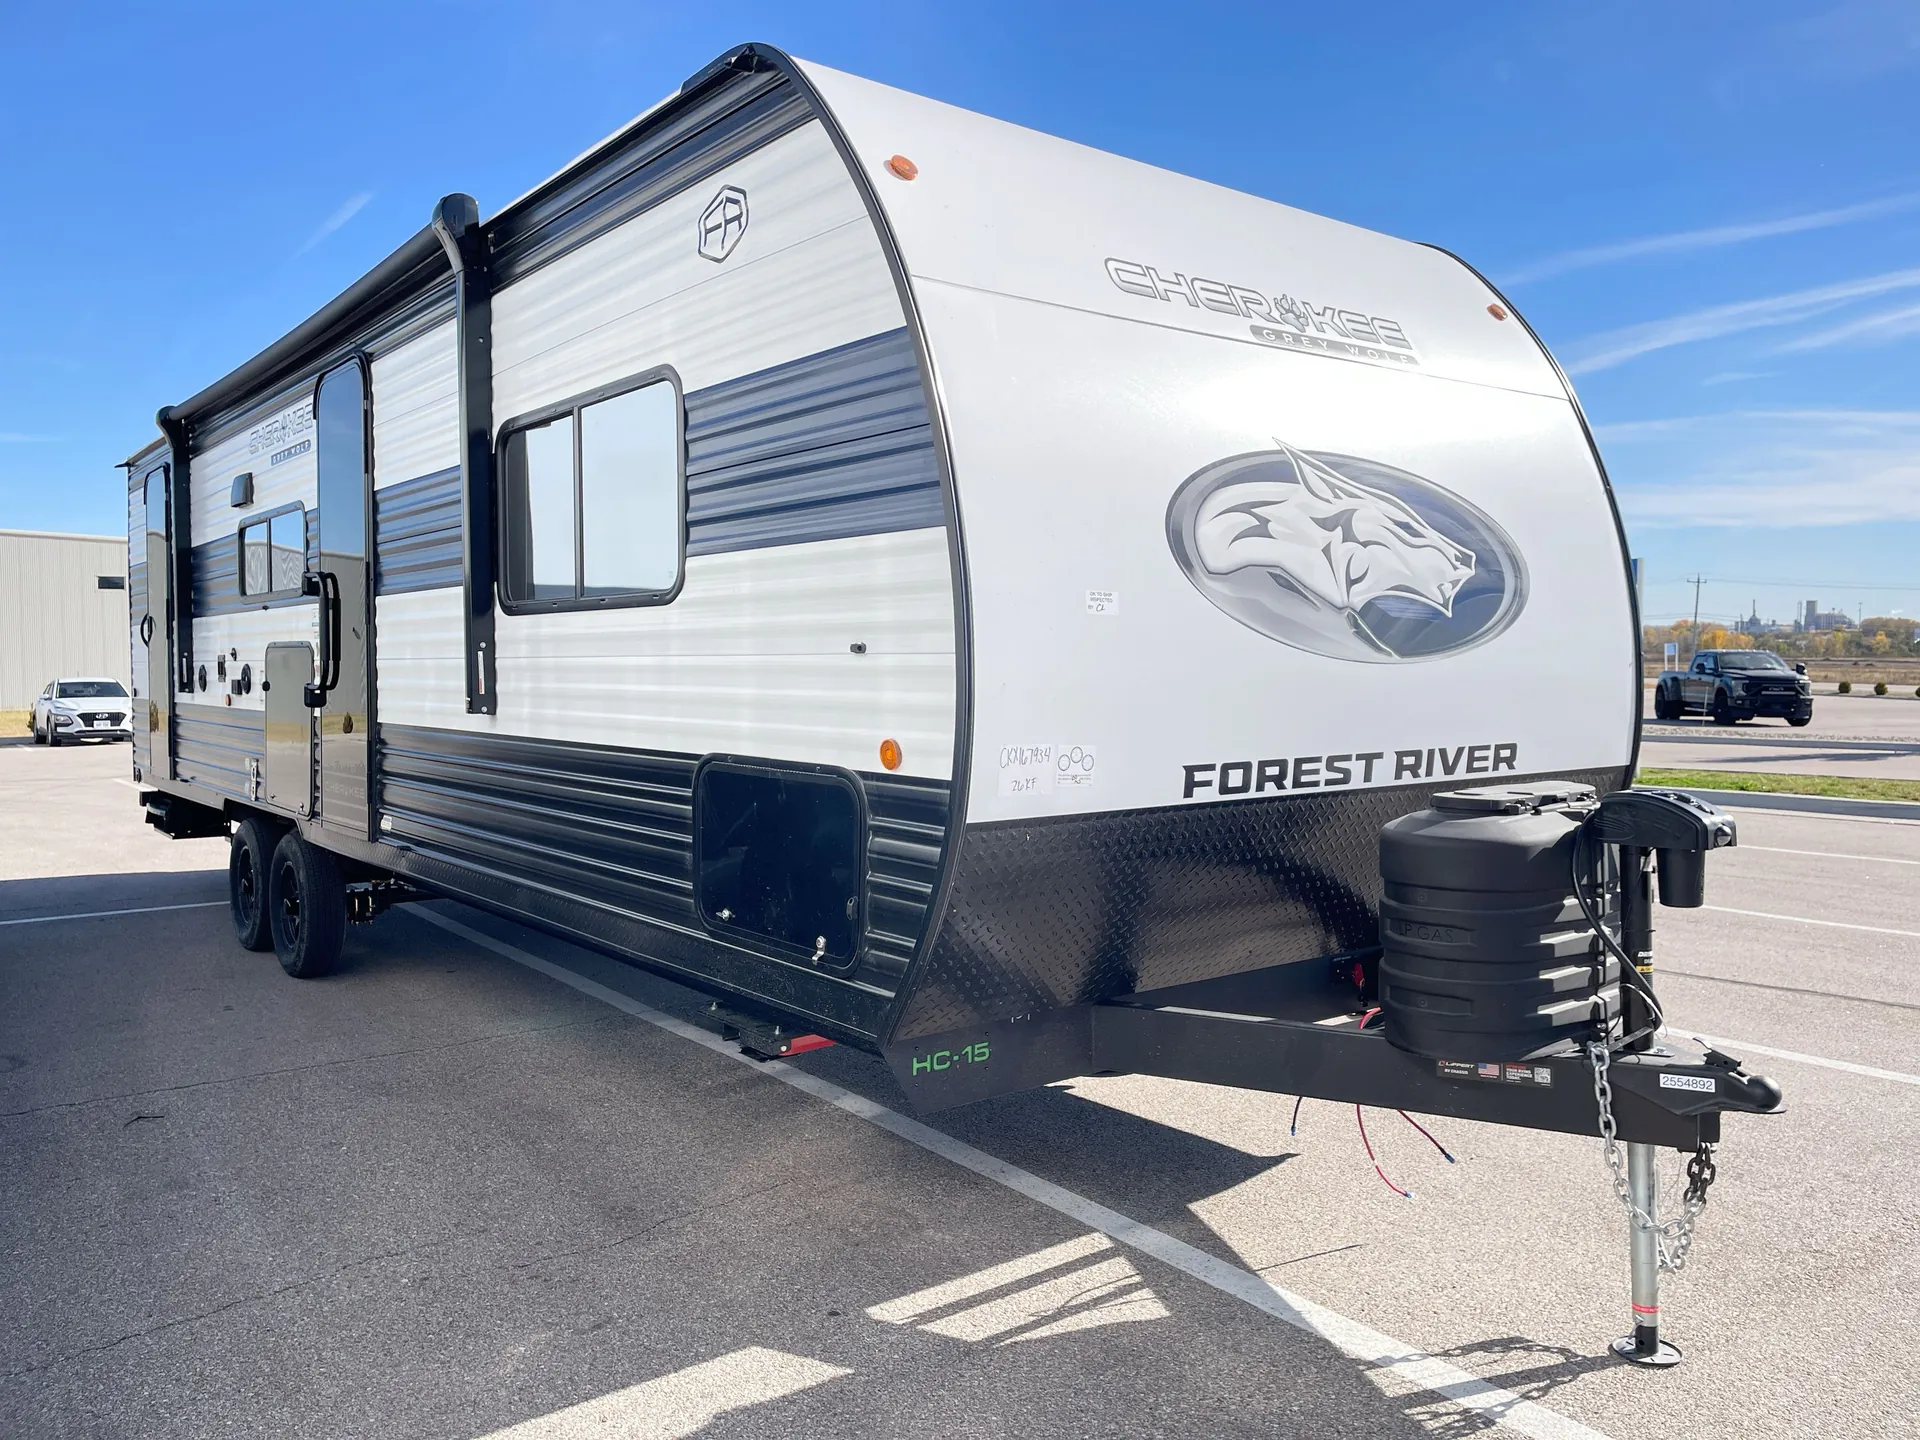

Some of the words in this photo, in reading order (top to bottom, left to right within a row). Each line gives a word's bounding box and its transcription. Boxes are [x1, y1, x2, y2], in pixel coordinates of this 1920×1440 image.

[1262, 328, 1330, 352] GREY
[1345, 343, 1411, 365] WOLF
[272, 451, 289, 464] GREY
[291, 441, 310, 455] WOLF
[1182, 751, 1384, 799] FOREST
[1394, 742, 1518, 781] RIVER
[1416, 925, 1455, 943] GAS
[912, 1041, 990, 1076] HC-15
[1662, 1076, 1713, 1090] 2554892
